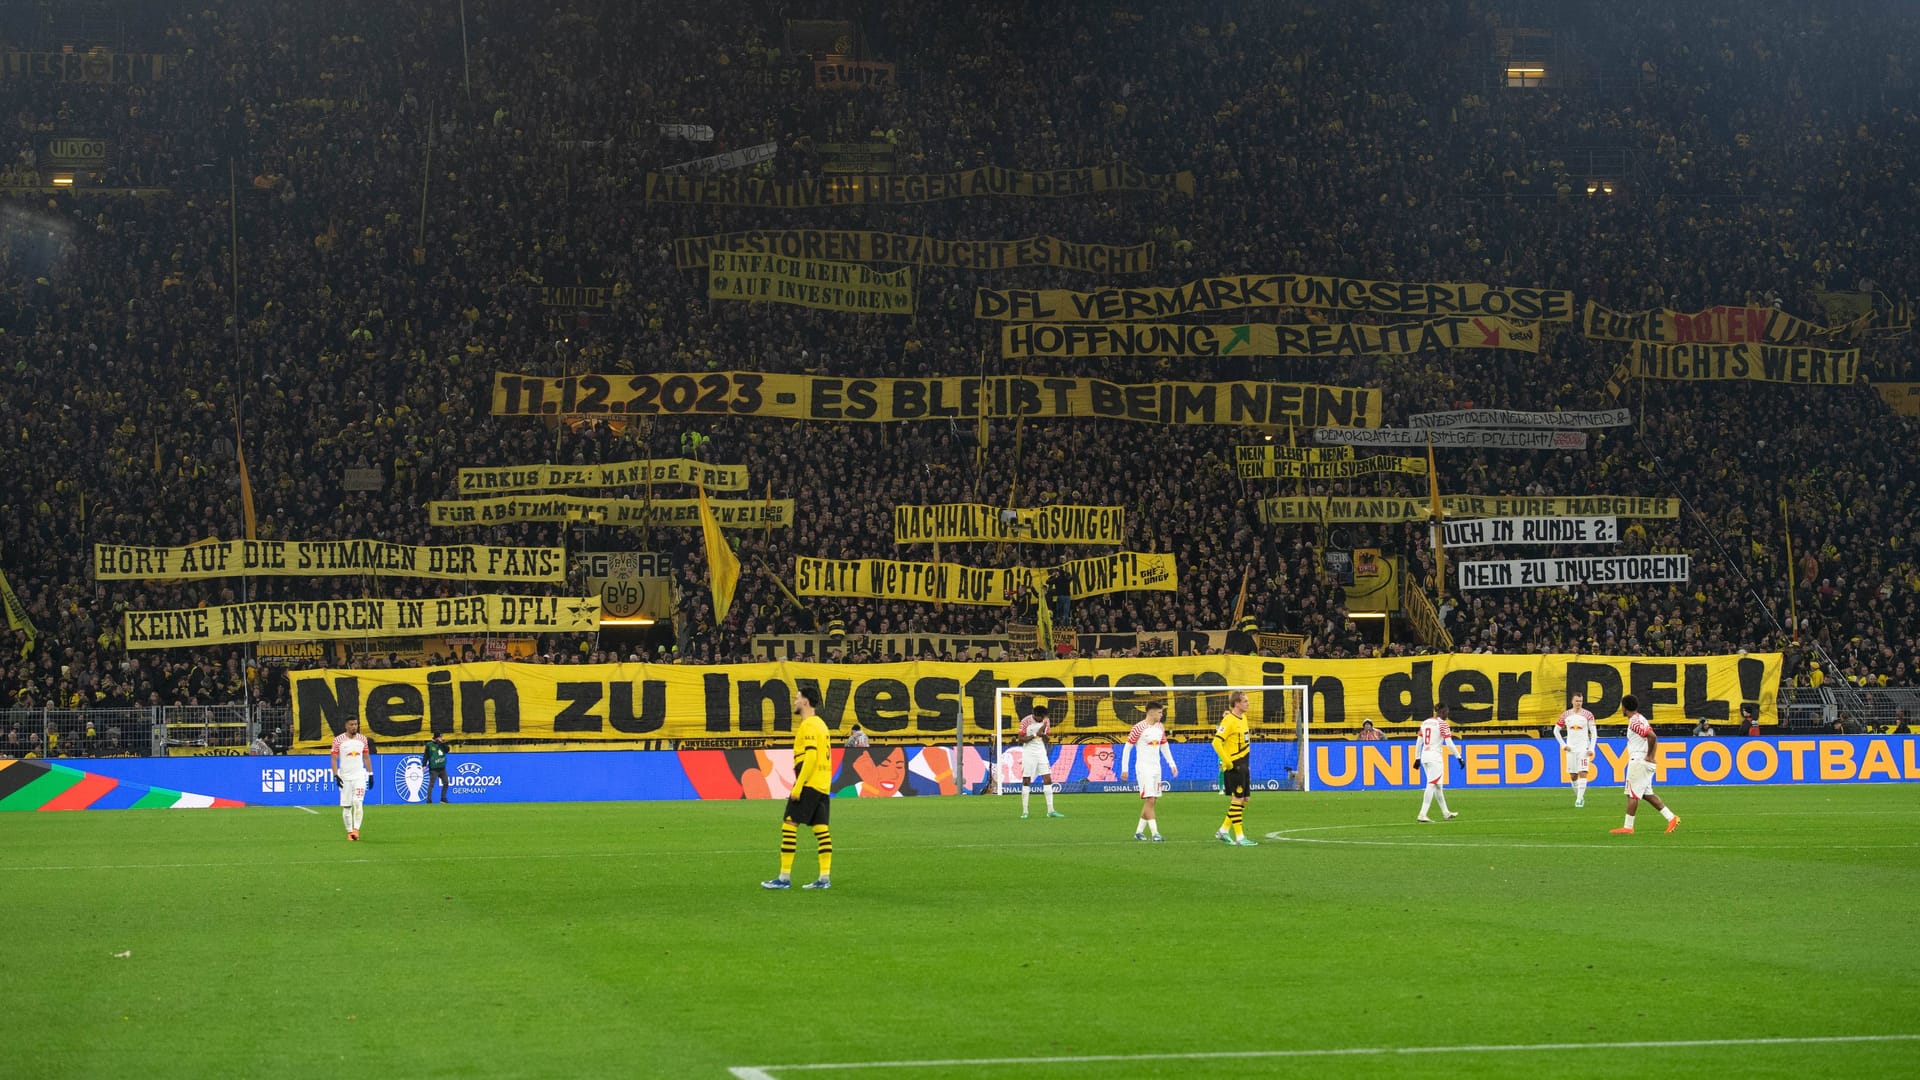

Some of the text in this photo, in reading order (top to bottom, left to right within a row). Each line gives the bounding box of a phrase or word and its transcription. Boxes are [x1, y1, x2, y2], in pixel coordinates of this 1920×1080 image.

[651, 175, 855, 206] ALTERNATIVEN
[865, 172, 961, 205] LIEGEN
[971, 168, 1025, 194] AUF
[1032, 168, 1093, 195] DEM
[678, 230, 1154, 273] INVESTOREN BRAUCHT ES NICHT!
[714, 252, 801, 278] EINFACH
[733, 278, 892, 309] AUF INVESTOREN
[980, 289, 1056, 319] DFL
[1590, 308, 1665, 341] EURE
[1675, 306, 1766, 343] ROTEN
[1010, 324, 1220, 356] HOFFNUNG
[1640, 344, 1854, 384] NICHTS WERT!
[501, 374, 764, 414] 11.12.2023
[811, 379, 878, 419] ES
[892, 379, 1077, 418] BLEIBT
[1091, 381, 1217, 423] BEIM
[1231, 383, 1369, 428] NEIN!
[1319, 430, 1410, 444] DEMOKRATIE
[1482, 431, 1554, 448] PFLICHT!
[1239, 447, 1265, 461] NEIN
[1273, 446, 1311, 461] BLEIBT
[463, 469, 539, 488] ZIRKUS
[549, 468, 592, 485] DFL:
[1238, 456, 1403, 478] KEIN DFL-ANTEILSVERKAUF!
[437, 502, 475, 521] FÜR
[618, 503, 699, 522] NUMMER
[1269, 500, 1321, 518] KEIN
[1496, 498, 1557, 516] EURE
[1566, 496, 1669, 515] HABGIER
[1492, 519, 1515, 541] IN
[1523, 518, 1588, 541] RUNDE
[1594, 519, 1614, 541] 2:
[100, 541, 560, 576] HÖRT AUF DIE STIMMEN DER FANS:
[799, 559, 861, 592] STATT
[958, 568, 993, 601] AUF
[1047, 553, 1137, 604] KUNFT!
[1464, 557, 1687, 587] NEIN ZU INVESTOREN!
[608, 581, 637, 604] BVB
[129, 597, 557, 641] KEINE INVESTOREN IN DER DFL!
[257, 643, 324, 657] HOOLIGANS
[298, 658, 1765, 742] Nein zu Investoren in der DFL!
[1425, 728, 1431, 745] 8
[458, 762, 483, 776] UEFA
[452, 787, 487, 795] GERMANY
[1104, 785, 1133, 793] SIGNAL
